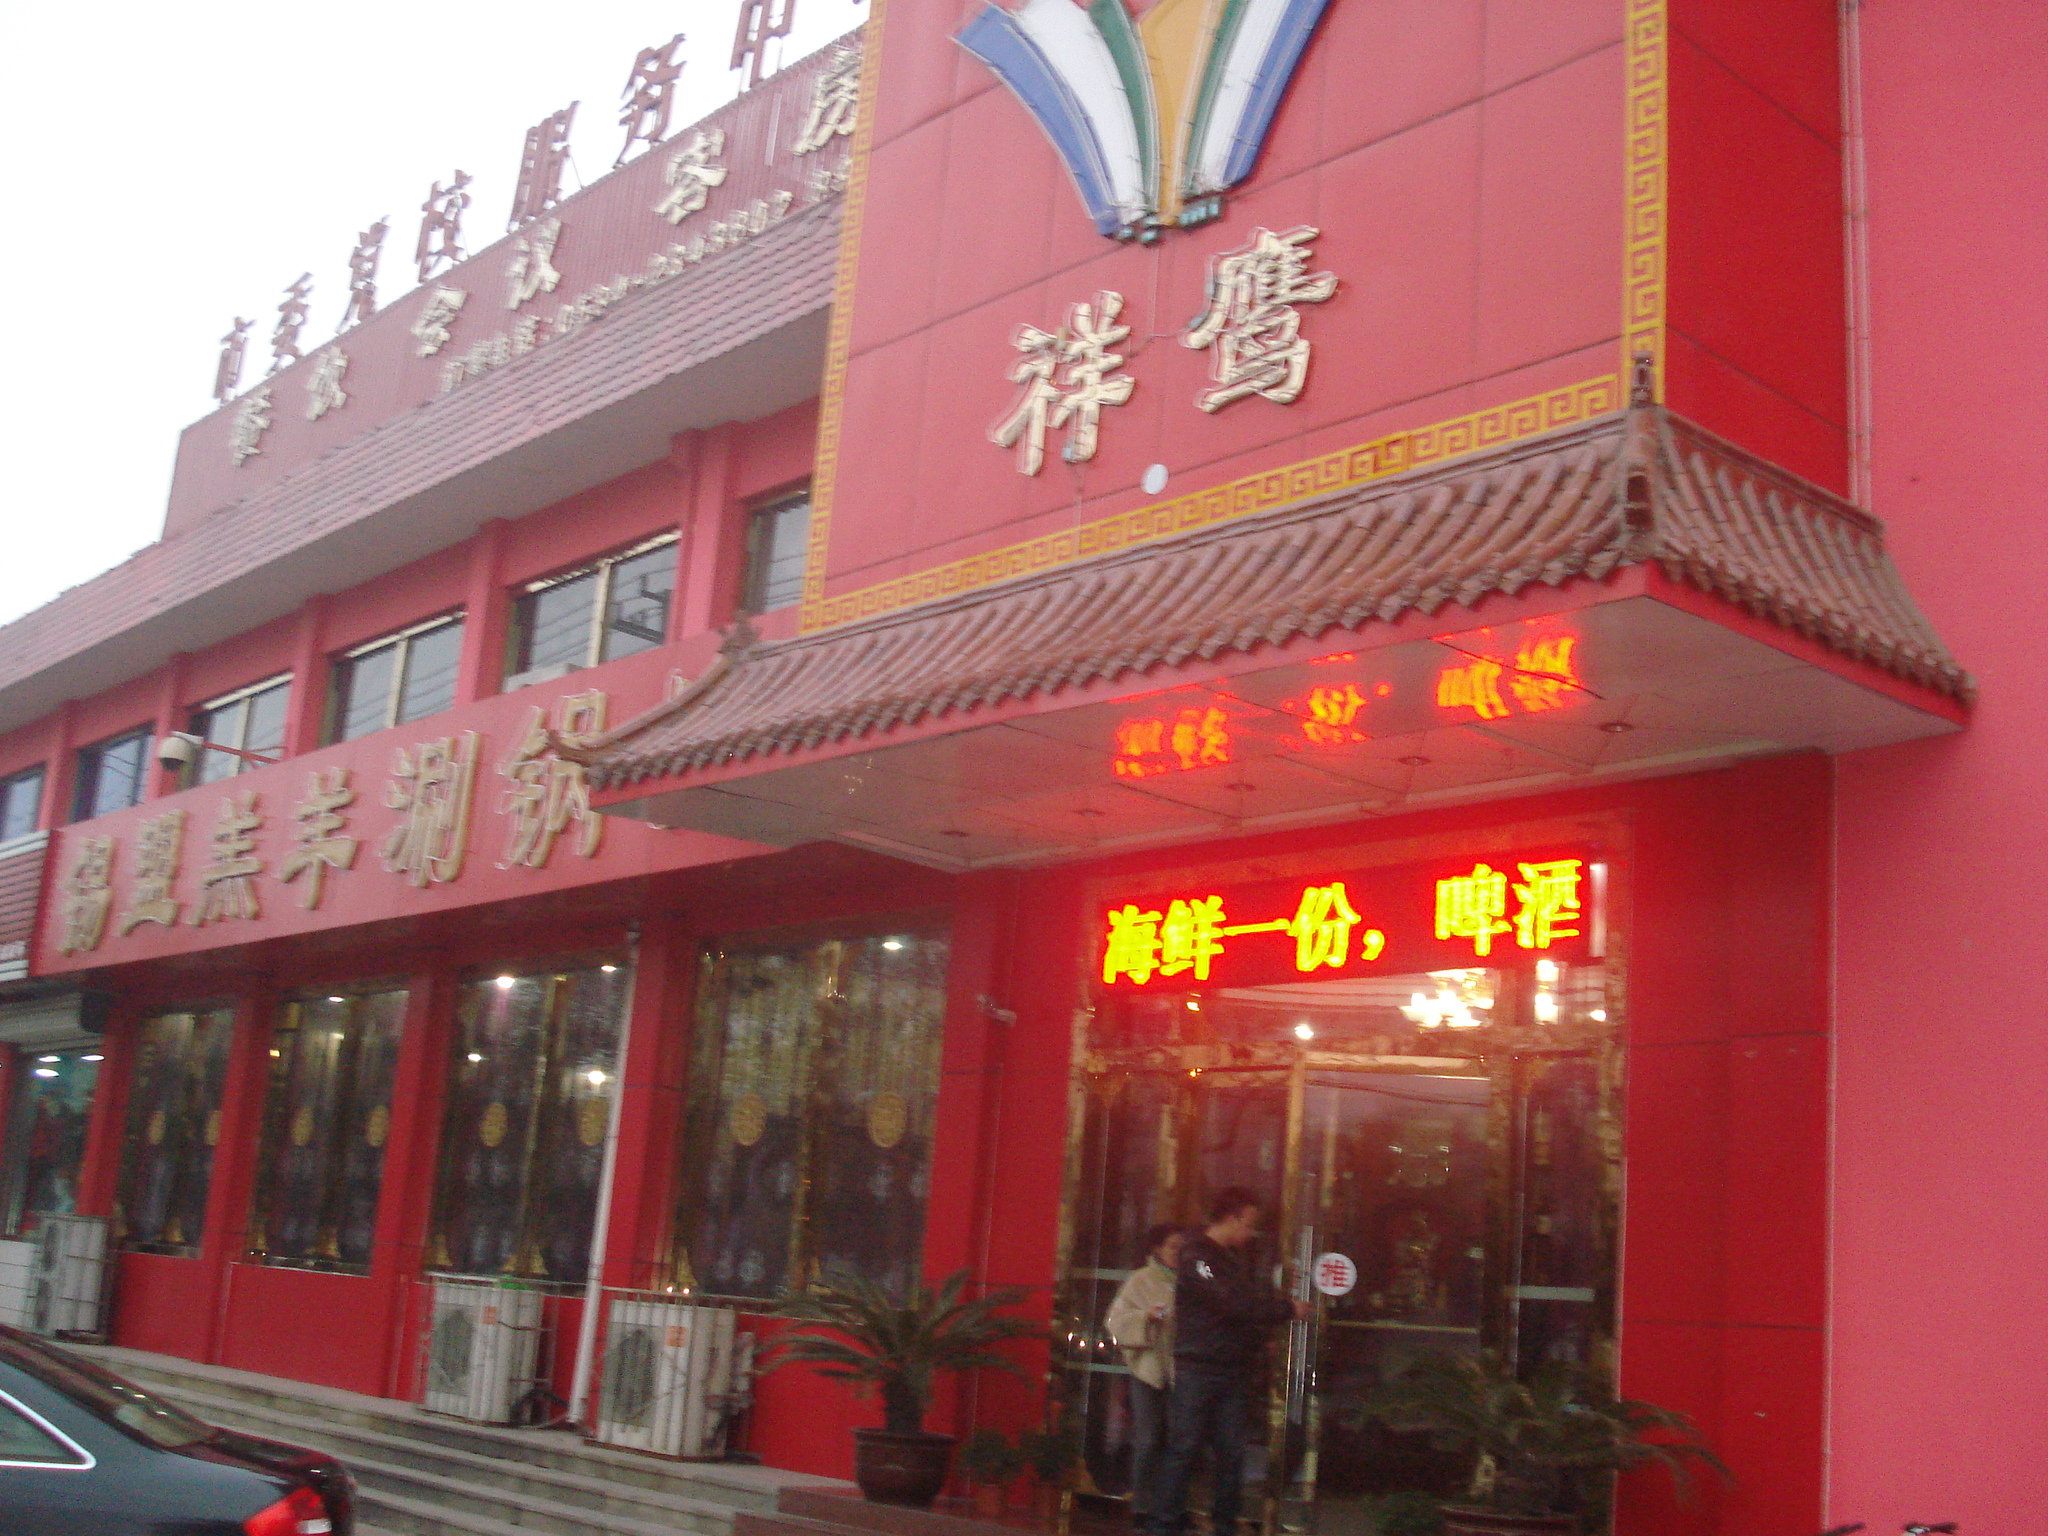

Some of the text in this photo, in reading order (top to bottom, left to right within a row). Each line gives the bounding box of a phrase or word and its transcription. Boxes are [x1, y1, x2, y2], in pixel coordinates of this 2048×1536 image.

[212, 0, 860, 404] 市委党校服务中
[988, 225, 1338, 475] 祥鹰
[57, 670, 692, 958] 锡盟羔羊涮锅
[1321, 1258, 1350, 1288] 推
